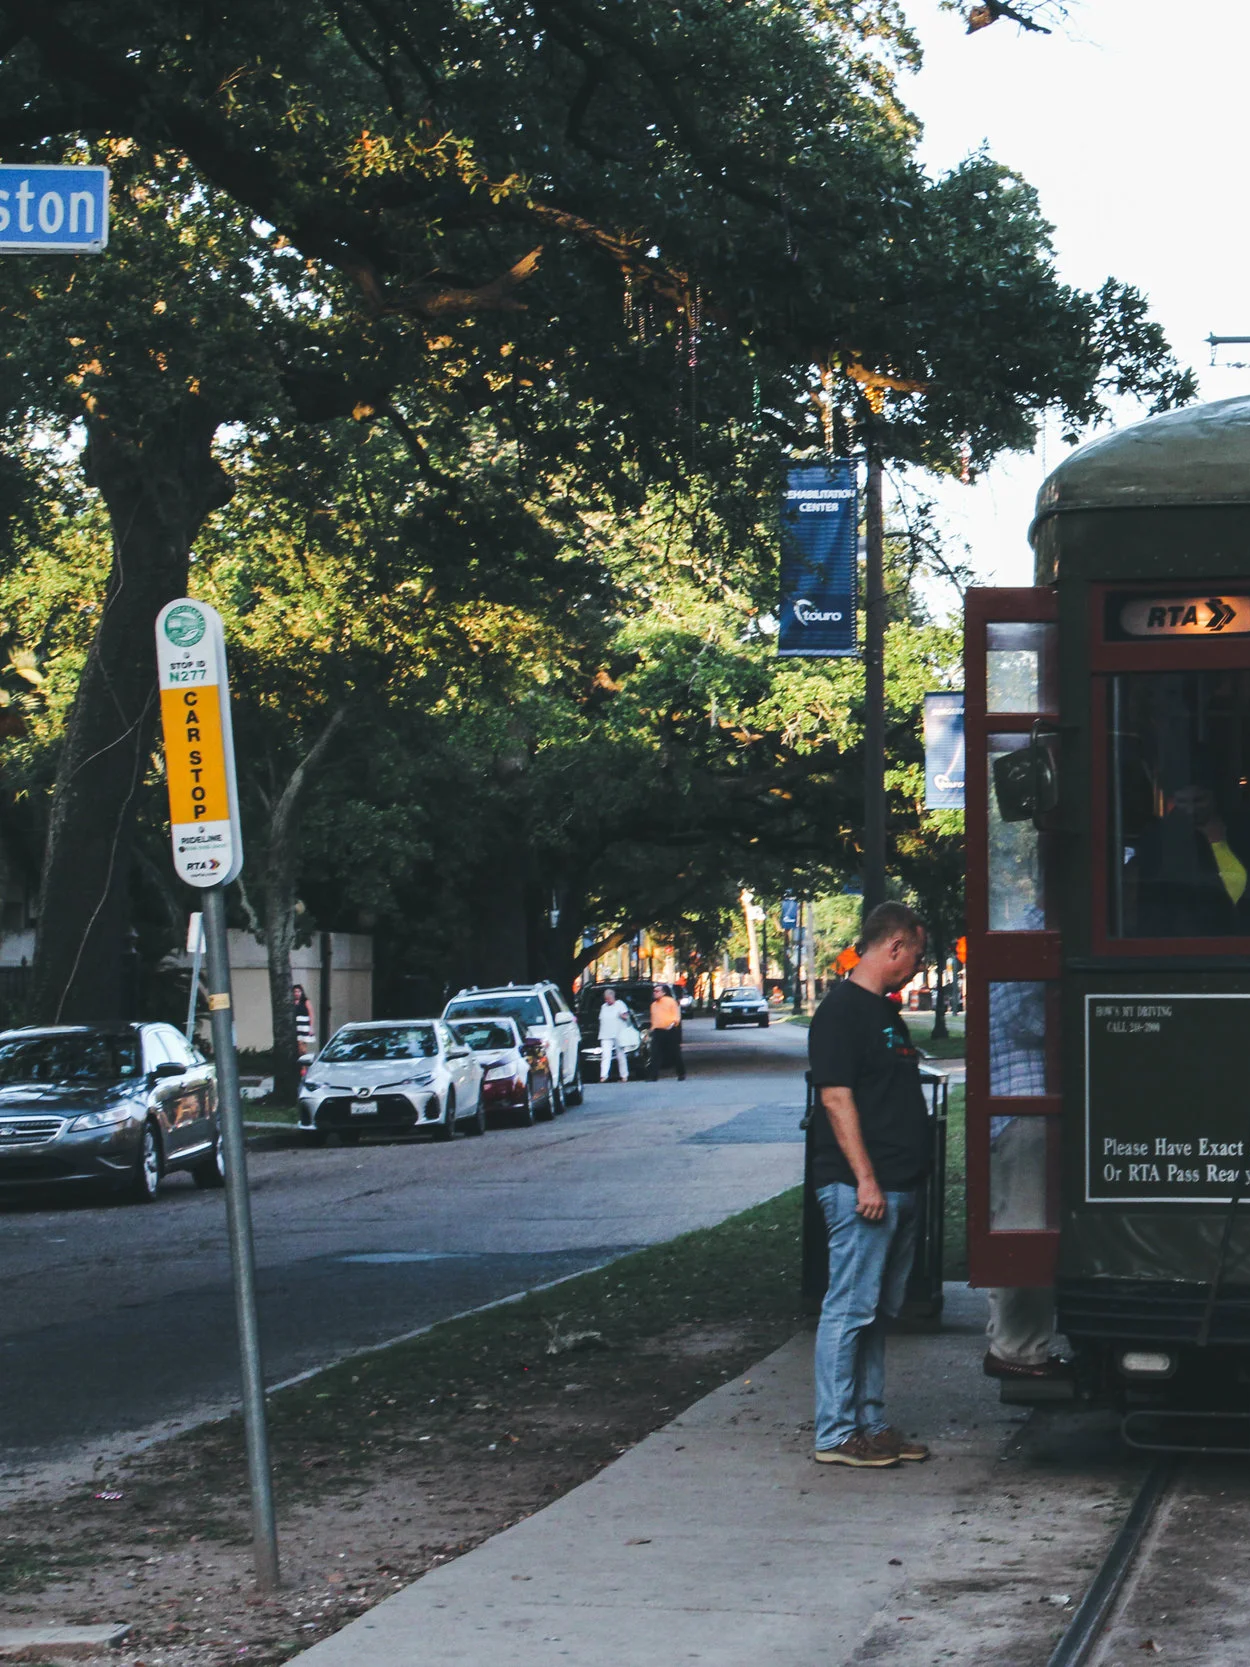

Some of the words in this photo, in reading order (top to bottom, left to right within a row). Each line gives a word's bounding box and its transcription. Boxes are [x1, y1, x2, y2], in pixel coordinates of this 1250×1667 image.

[799, 502, 839, 513] CENTER
[802, 610, 842, 622] touro
[1147, 605, 1199, 628] RTA
[170, 660, 196, 670] STOP
[196, 659, 206, 668] ID
[169, 669, 207, 684] N277
[184, 692, 200, 743] CAR
[189, 750, 207, 820] STOP
[181, 834, 222, 844] RIDELINE
[186, 861, 206, 871] RTA
[1106, 1021, 1128, 1033] CALL
[1103, 1137, 1149, 1156] Please
[1155, 1137, 1192, 1156] Have
[1198, 1137, 1244, 1156] Exact
[1104, 1163, 1123, 1182] Or
[1128, 1163, 1161, 1182] RTA
[1166, 1163, 1200, 1182] Pass
